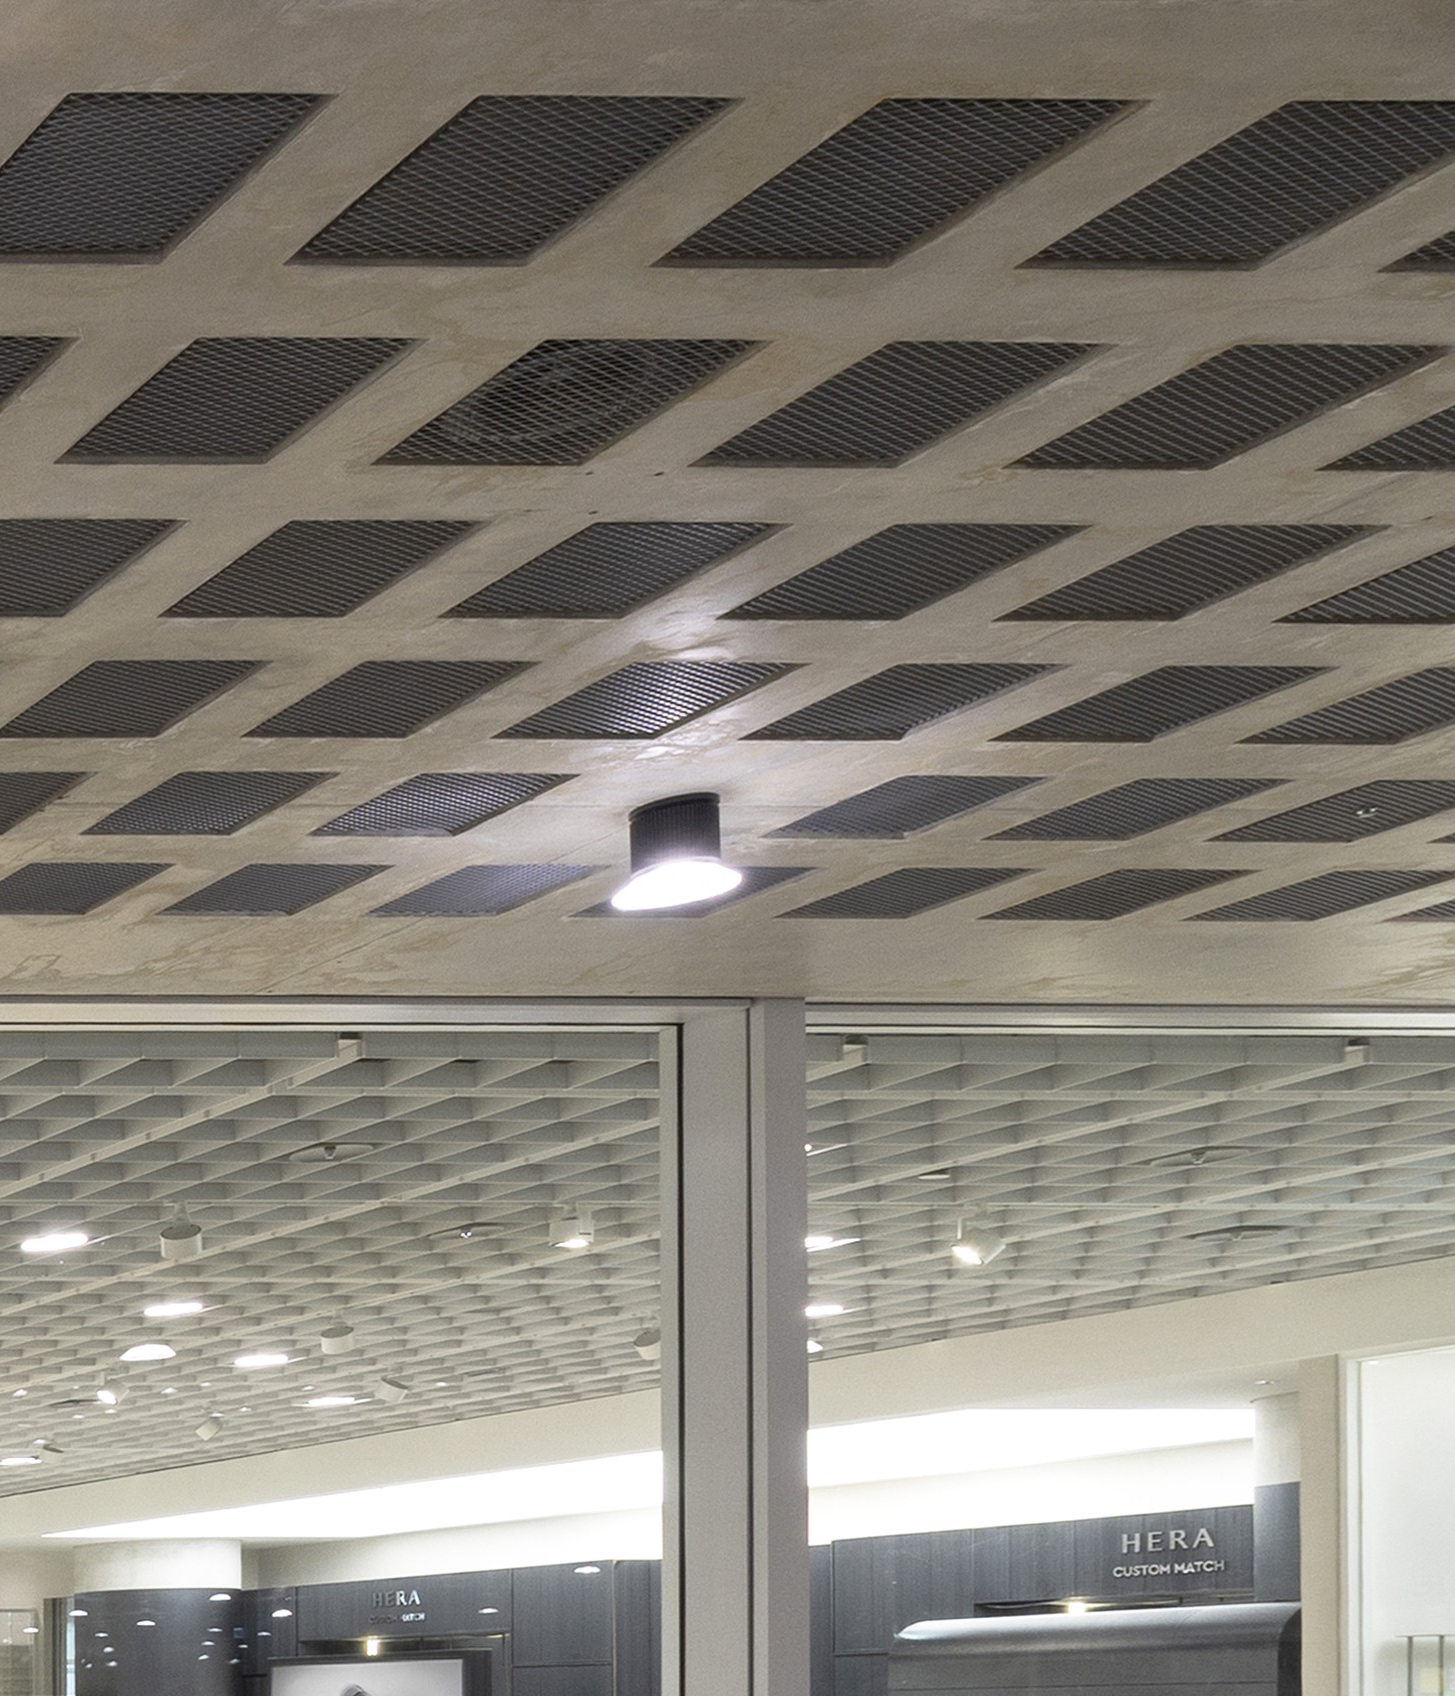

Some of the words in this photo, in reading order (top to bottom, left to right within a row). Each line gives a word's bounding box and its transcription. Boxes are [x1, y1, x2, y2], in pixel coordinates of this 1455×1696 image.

[1121, 1527, 1215, 1554] HERA
[1112, 1564, 1171, 1578] CUSTOM
[1174, 1560, 1225, 1574] MATCH
[372, 1589, 421, 1607] HERA
